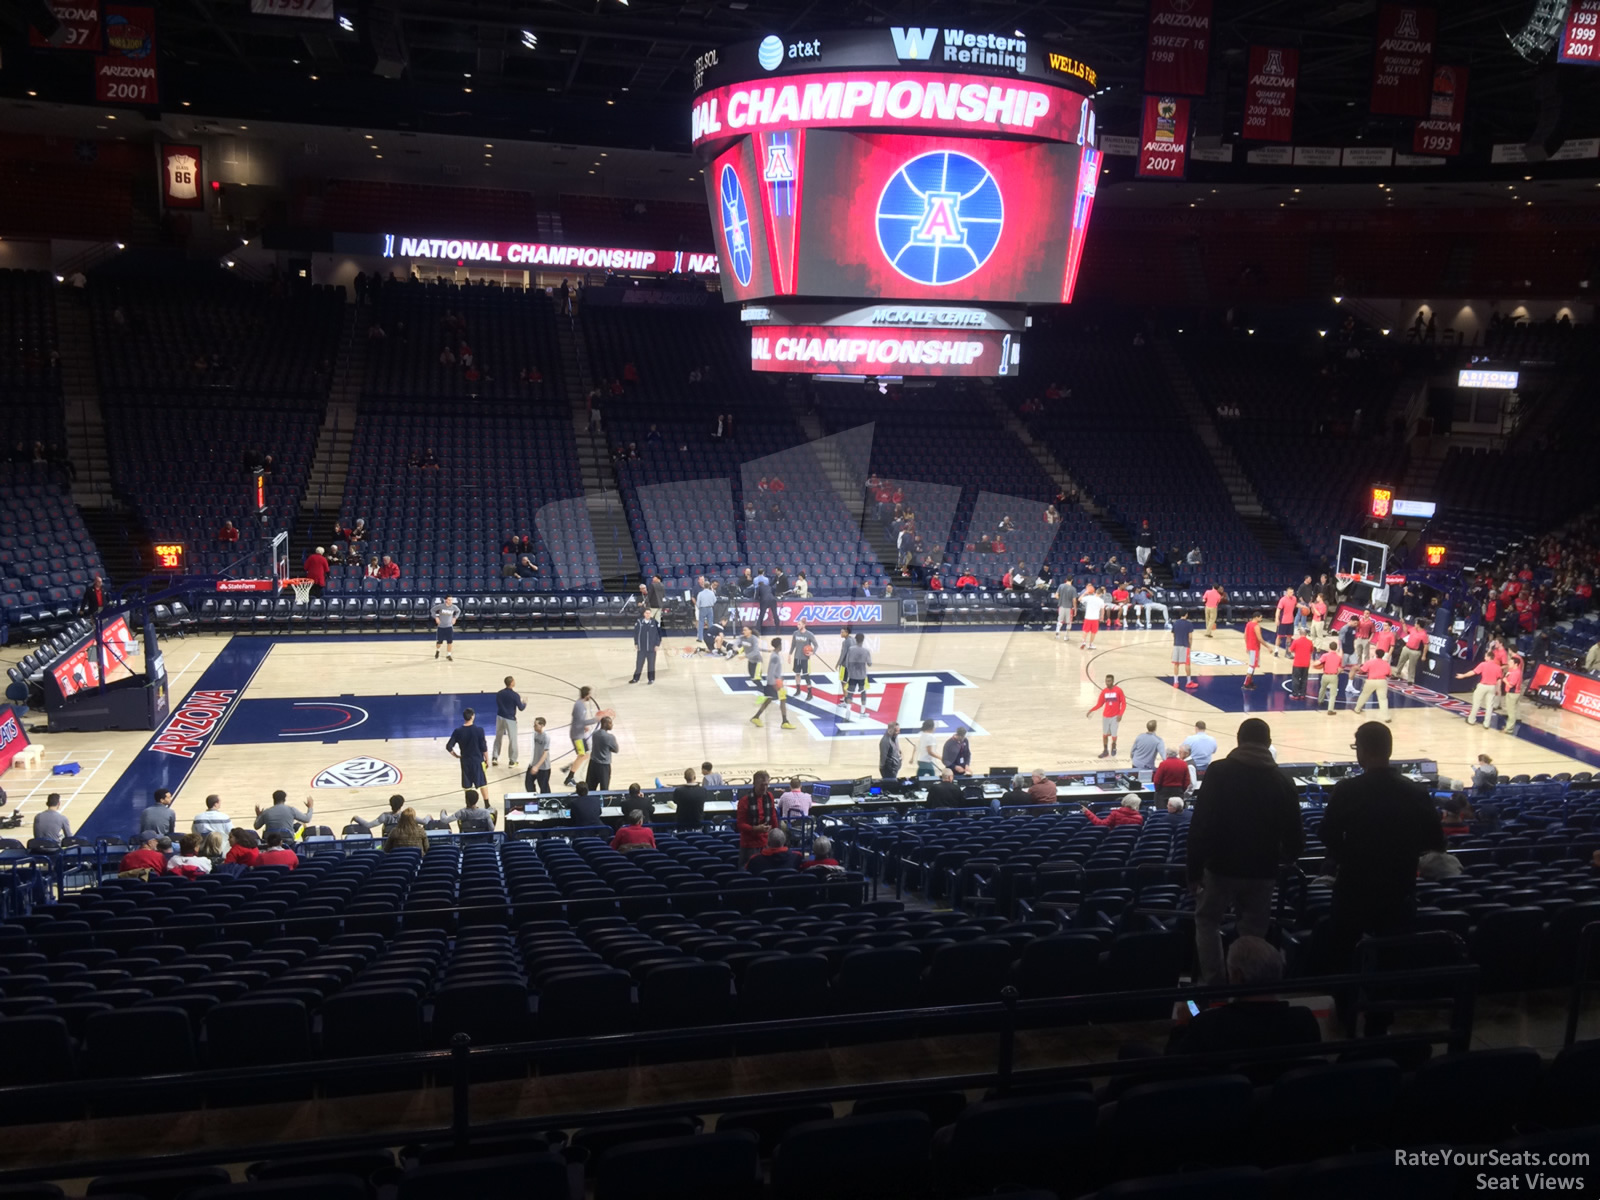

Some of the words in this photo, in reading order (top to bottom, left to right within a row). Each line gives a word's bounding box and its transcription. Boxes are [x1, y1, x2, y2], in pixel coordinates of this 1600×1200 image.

[1153, 13, 1209, 29] ARIZONA
[1573, 12, 1598, 25] 1993
[944, 29, 1027, 53] Western
[1571, 27, 1596, 41] 1999
[788, 40, 821, 58] at&t
[1152, 35, 1190, 48] SWEET
[1193, 40, 1205, 50] 16
[1380, 39, 1431, 54] ARIZONA
[1567, 42, 1594, 56] 2001
[704, 50, 718, 69] SOL
[944, 47, 1027, 73] Refining
[1151, 51, 1175, 63] 1998
[100, 65, 155, 79] ARIZONA
[1049, 52, 1084, 78] WELLS
[1250, 74, 1296, 88] ARIZONA
[107, 83, 147, 99] 2001
[727, 81, 1050, 128] CHAMPIONSHIP
[1419, 120, 1461, 132] ARIZONA
[1144, 142, 1185, 153] ARIZONA
[1423, 136, 1453, 151] 1993
[1146, 157, 1176, 171] 2001
[175, 171, 191, 184] 86
[400, 238, 502, 262] NATIONAL
[507, 244, 656, 269] CHAMPIONSHIP
[937, 311, 987, 324] CENTER
[775, 337, 984, 365] CHAMPIONSHIP
[156, 545, 182, 555] 55:27
[163, 555, 178, 567] 30
[794, 604, 882, 622] ARIZONA
[148, 689, 238, 759] ARIZONA
